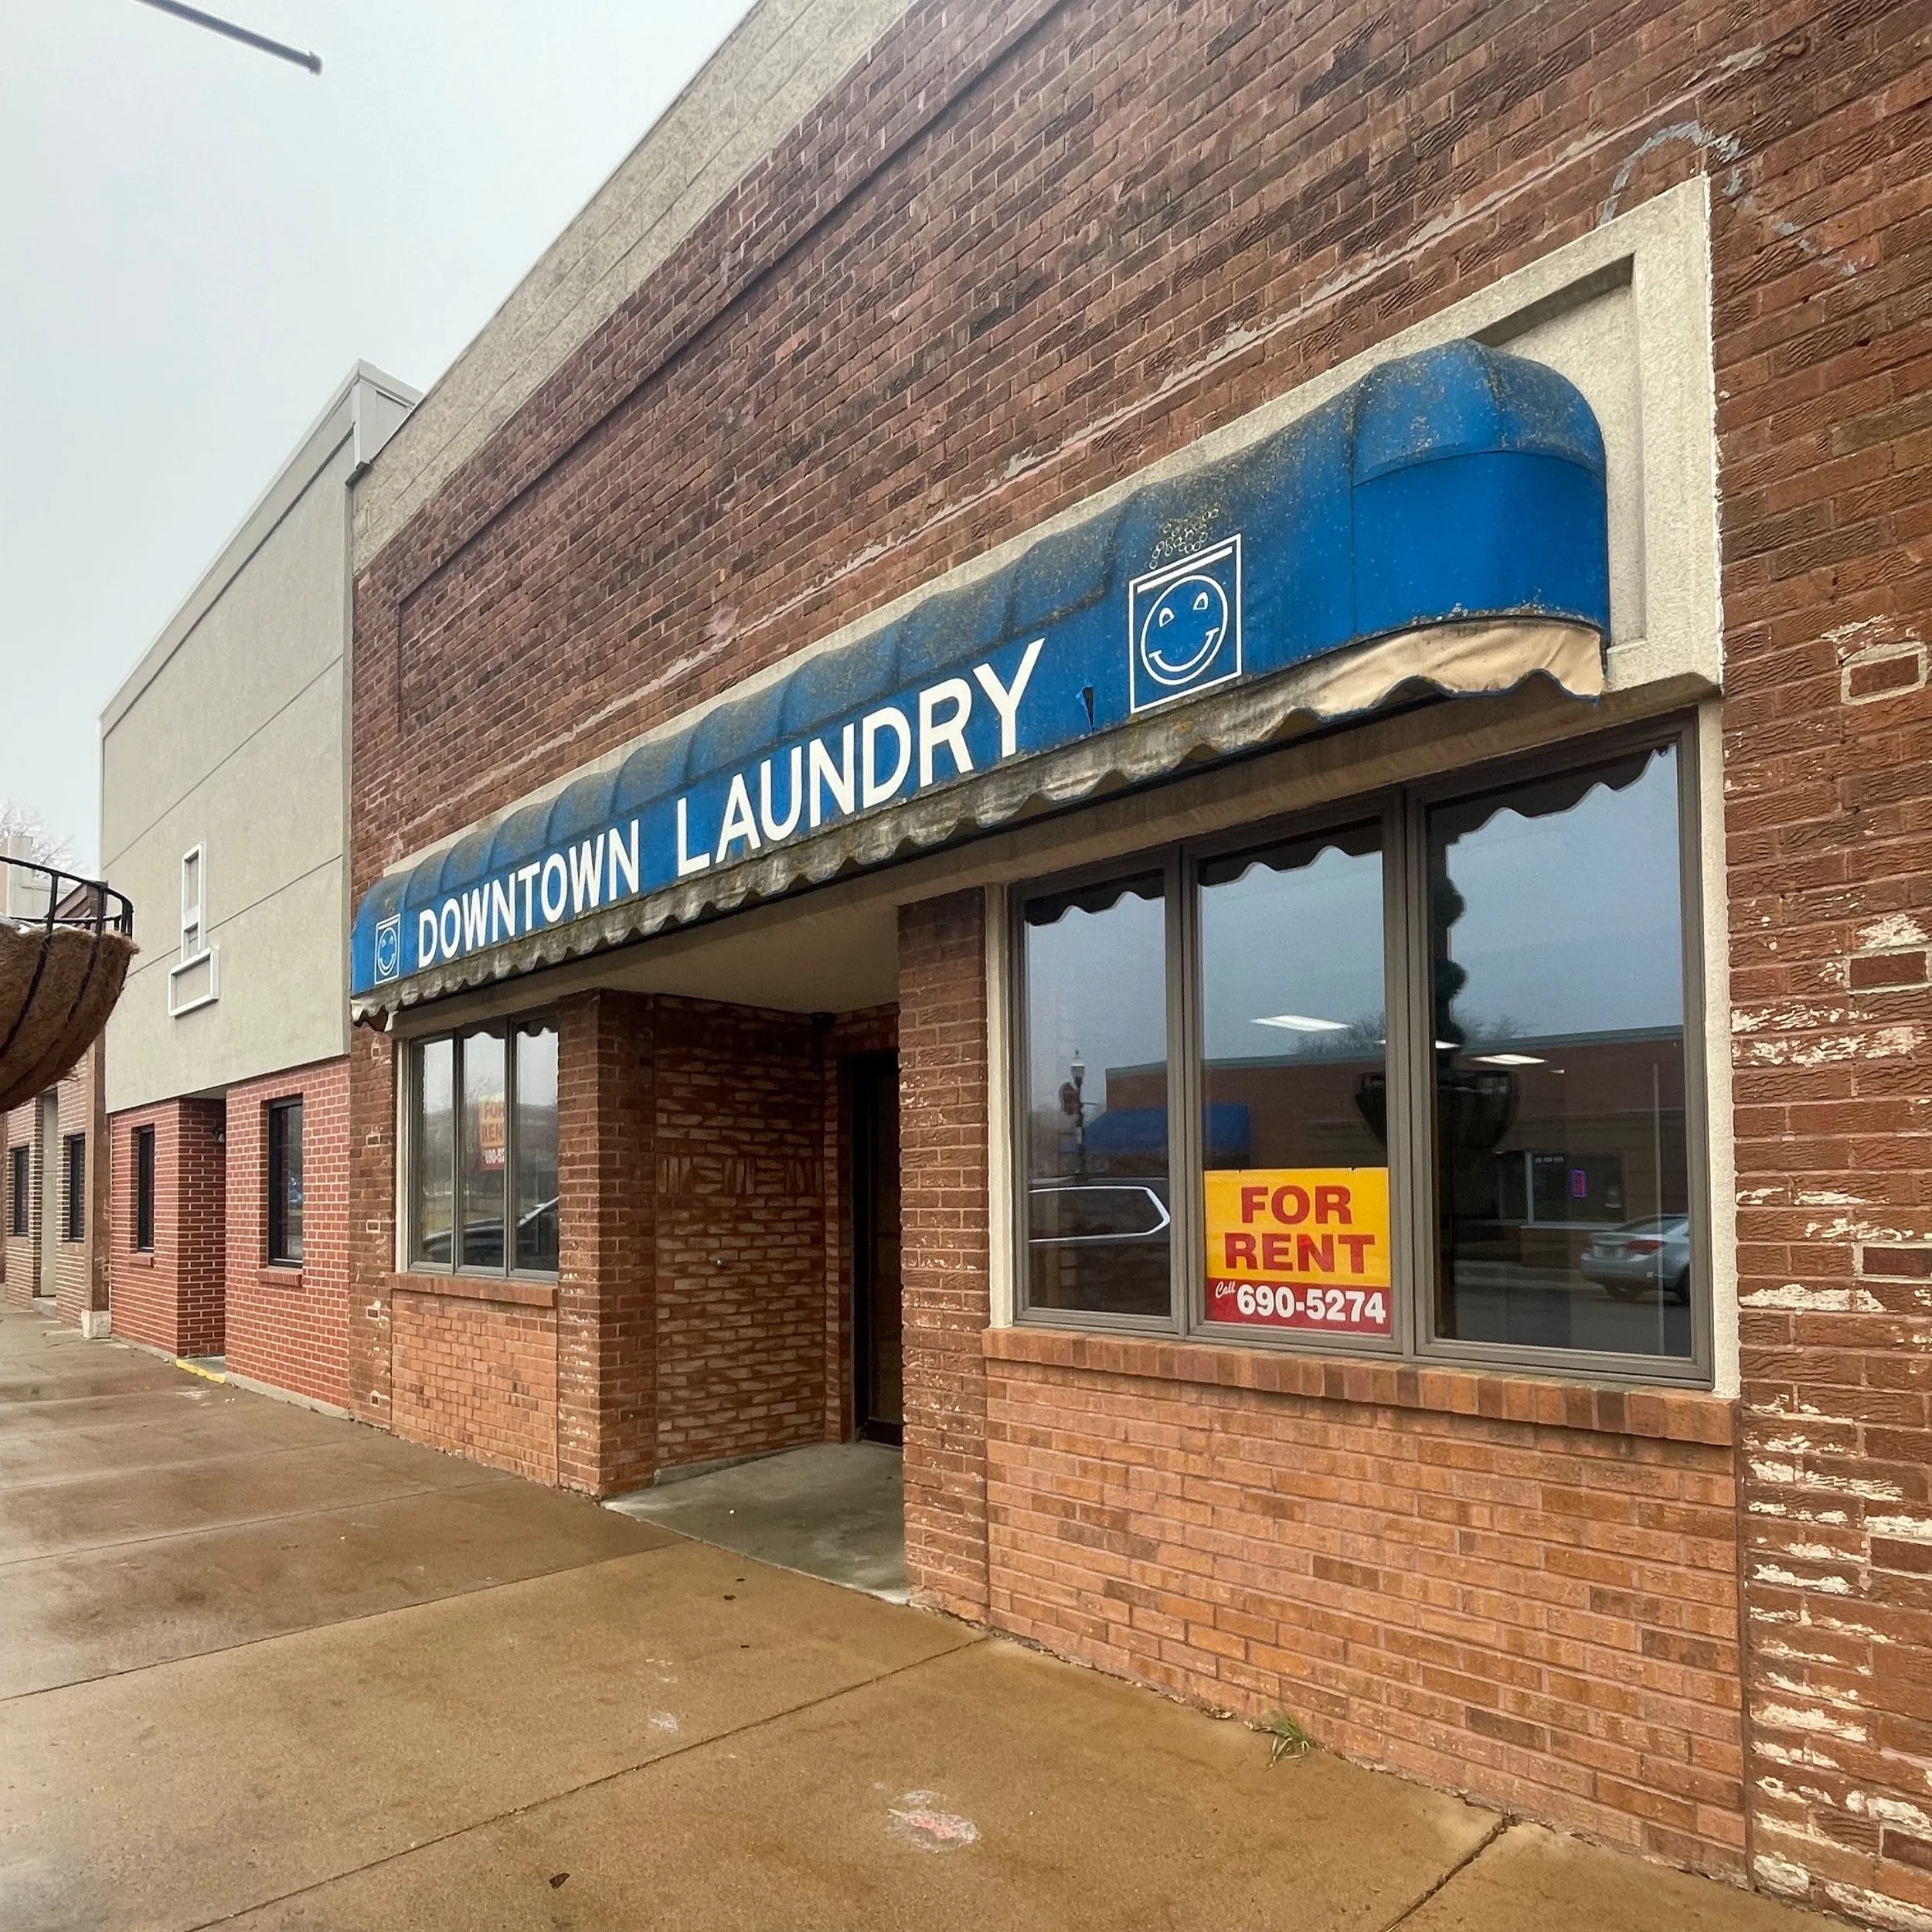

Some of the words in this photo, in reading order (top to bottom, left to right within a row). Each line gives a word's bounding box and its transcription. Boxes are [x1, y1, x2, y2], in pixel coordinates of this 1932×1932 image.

[418, 819, 639, 968] DOWNTOWN
[677, 638, 1045, 877] LAUNDRY
[481, 1123, 503, 1142] REN
[1240, 1185, 1352, 1225] FOR
[1224, 1232, 1376, 1274] RENT
[1215, 1281, 1236, 1299] Call
[1236, 1284, 1386, 1324] 690-5274
